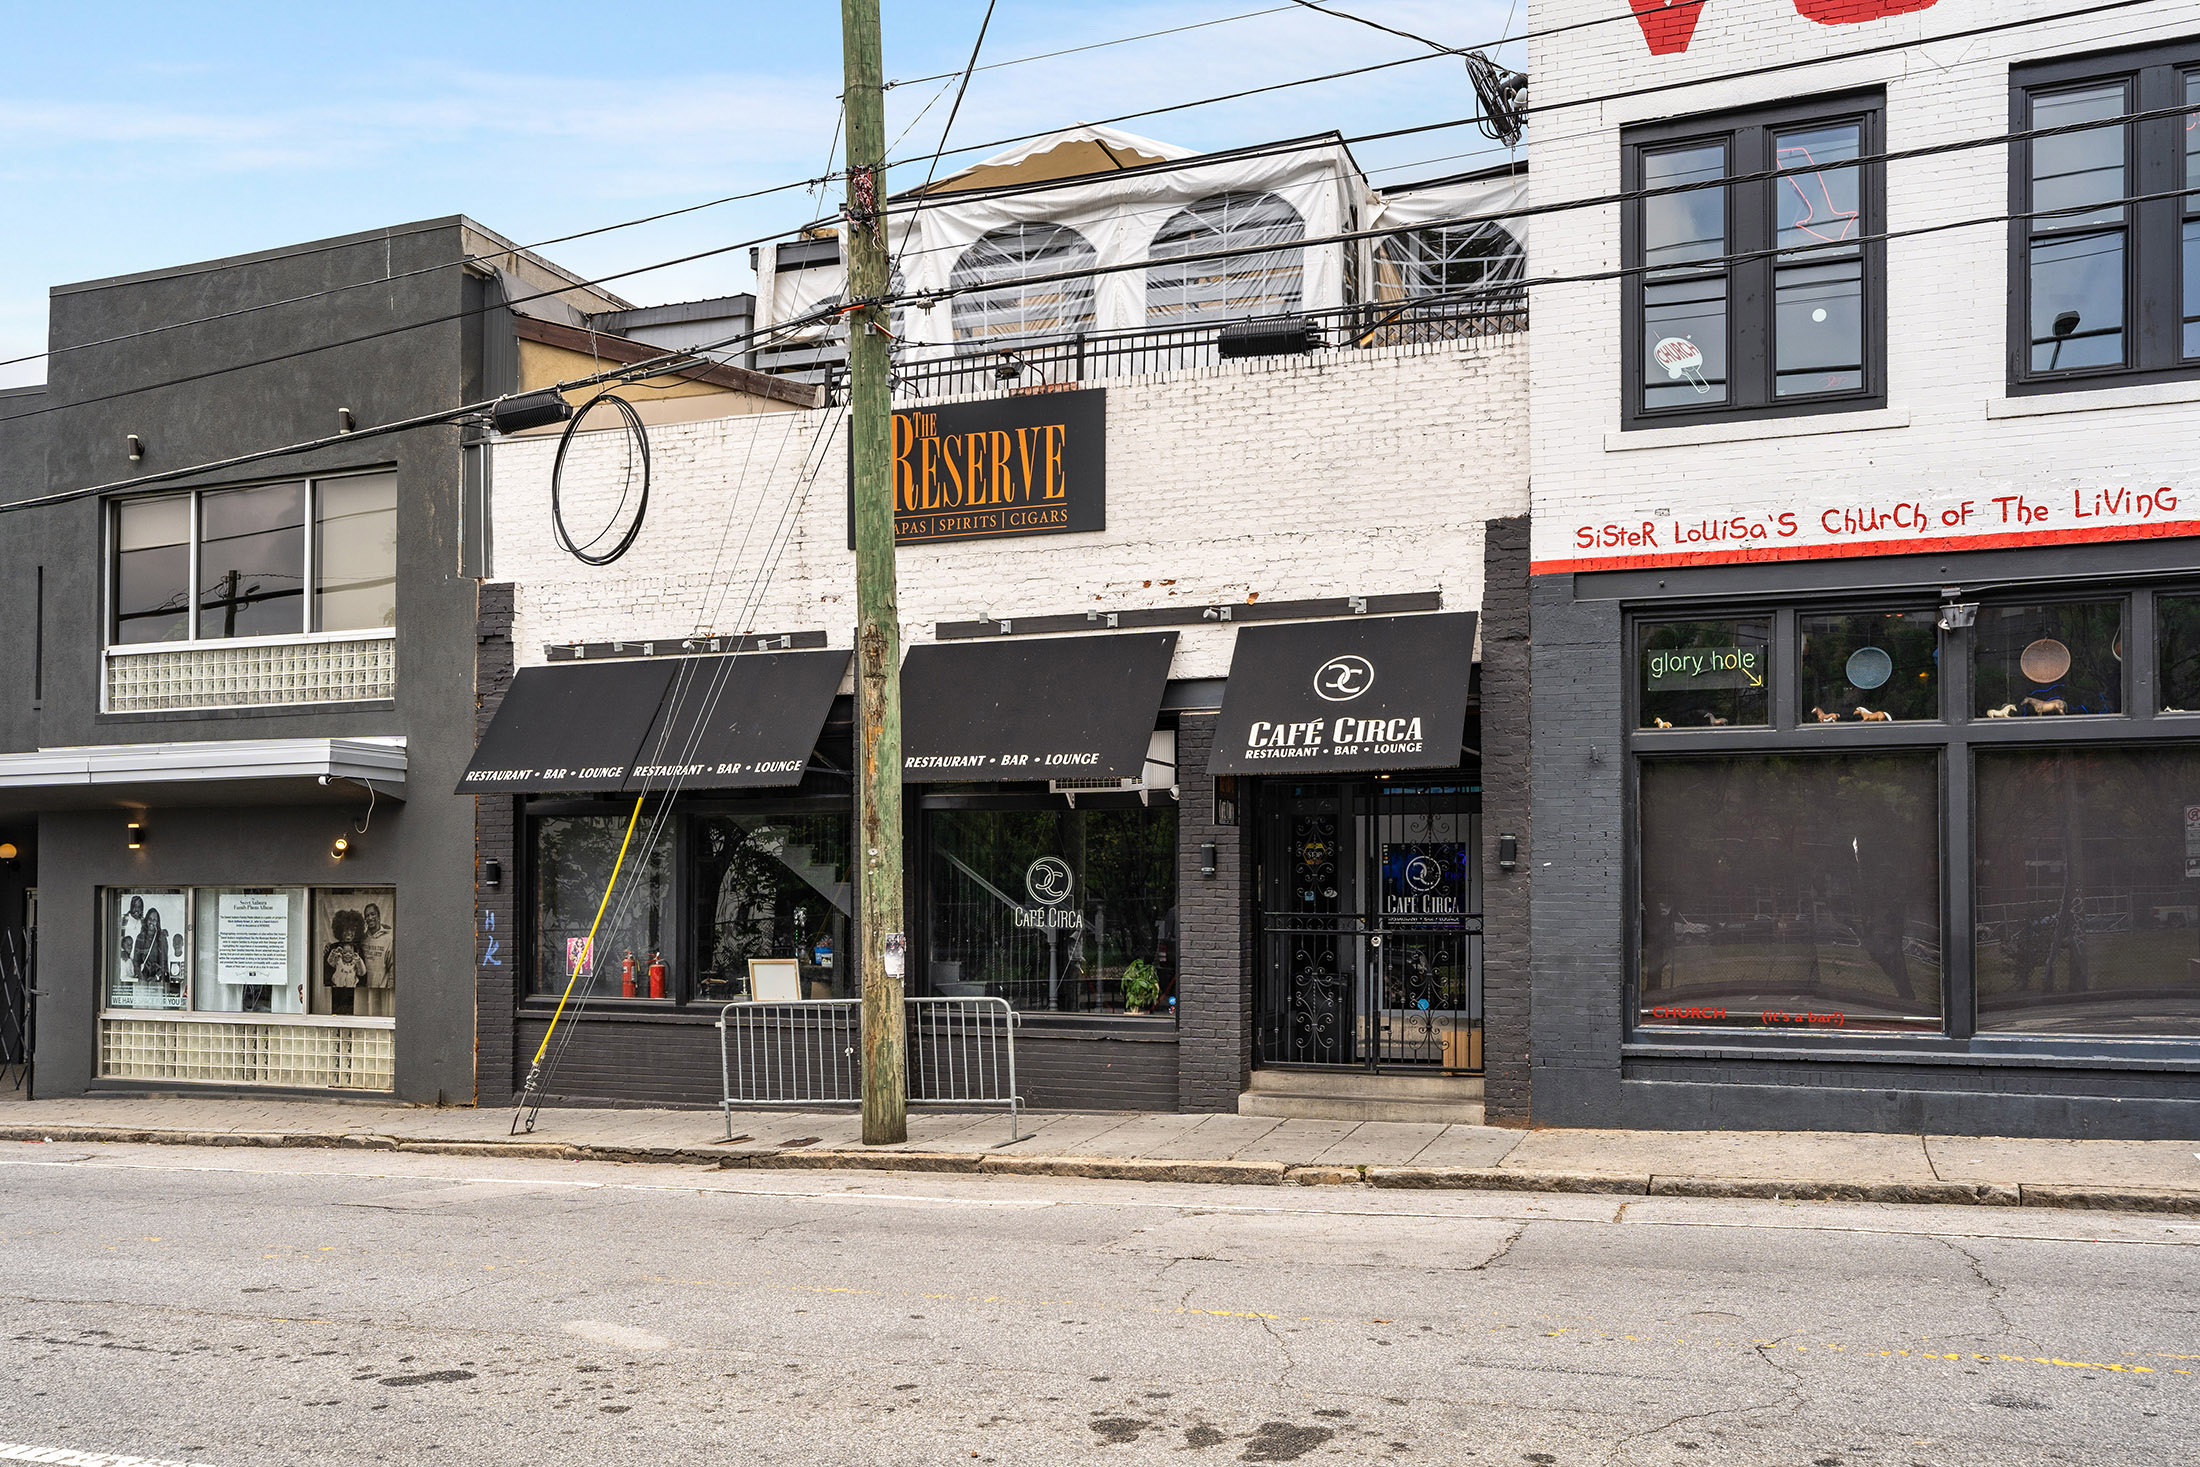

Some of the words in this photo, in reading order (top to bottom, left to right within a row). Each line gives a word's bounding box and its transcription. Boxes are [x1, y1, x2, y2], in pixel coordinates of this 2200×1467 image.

[1657, 341, 1700, 363] CHURCH
[913, 412, 937, 438] THE
[892, 414, 1066, 512] RESERVE
[1992, 495, 2049, 526] The
[894, 519, 926, 535] APAS
[939, 515, 997, 531] SPIRITS
[1010, 509, 1068, 526] CIGARS
[1651, 652, 1703, 678] glory
[1712, 648, 1755, 671] hole
[1247, 718, 1325, 747] CAFÉ
[1333, 717, 1423, 743] CIRCA
[905, 755, 986, 768] RESTAURANT
[1001, 754, 1028, 766] BAR
[1045, 753, 1099, 765] LOUNGE
[1245, 747, 1319, 759] RESTAURANT
[1334, 745, 1358, 755] BAR
[1374, 742, 1423, 754] LOUNGE
[466, 769, 532, 782] RESTAURANT
[543, 768, 566, 779] BAR
[578, 767, 624, 779] LOUNGE
[633, 765, 705, 777] RESTAURANT
[716, 763, 741, 774] BAR
[754, 760, 803, 773] LOUNGE
[1048, 907, 1083, 928] CIRCA
[1652, 1006, 1726, 1019] CHURCH
[1762, 1009, 1790, 1025] (it's
[1794, 1014, 1803, 1022] a
[1807, 1011, 1845, 1026] bar!)
